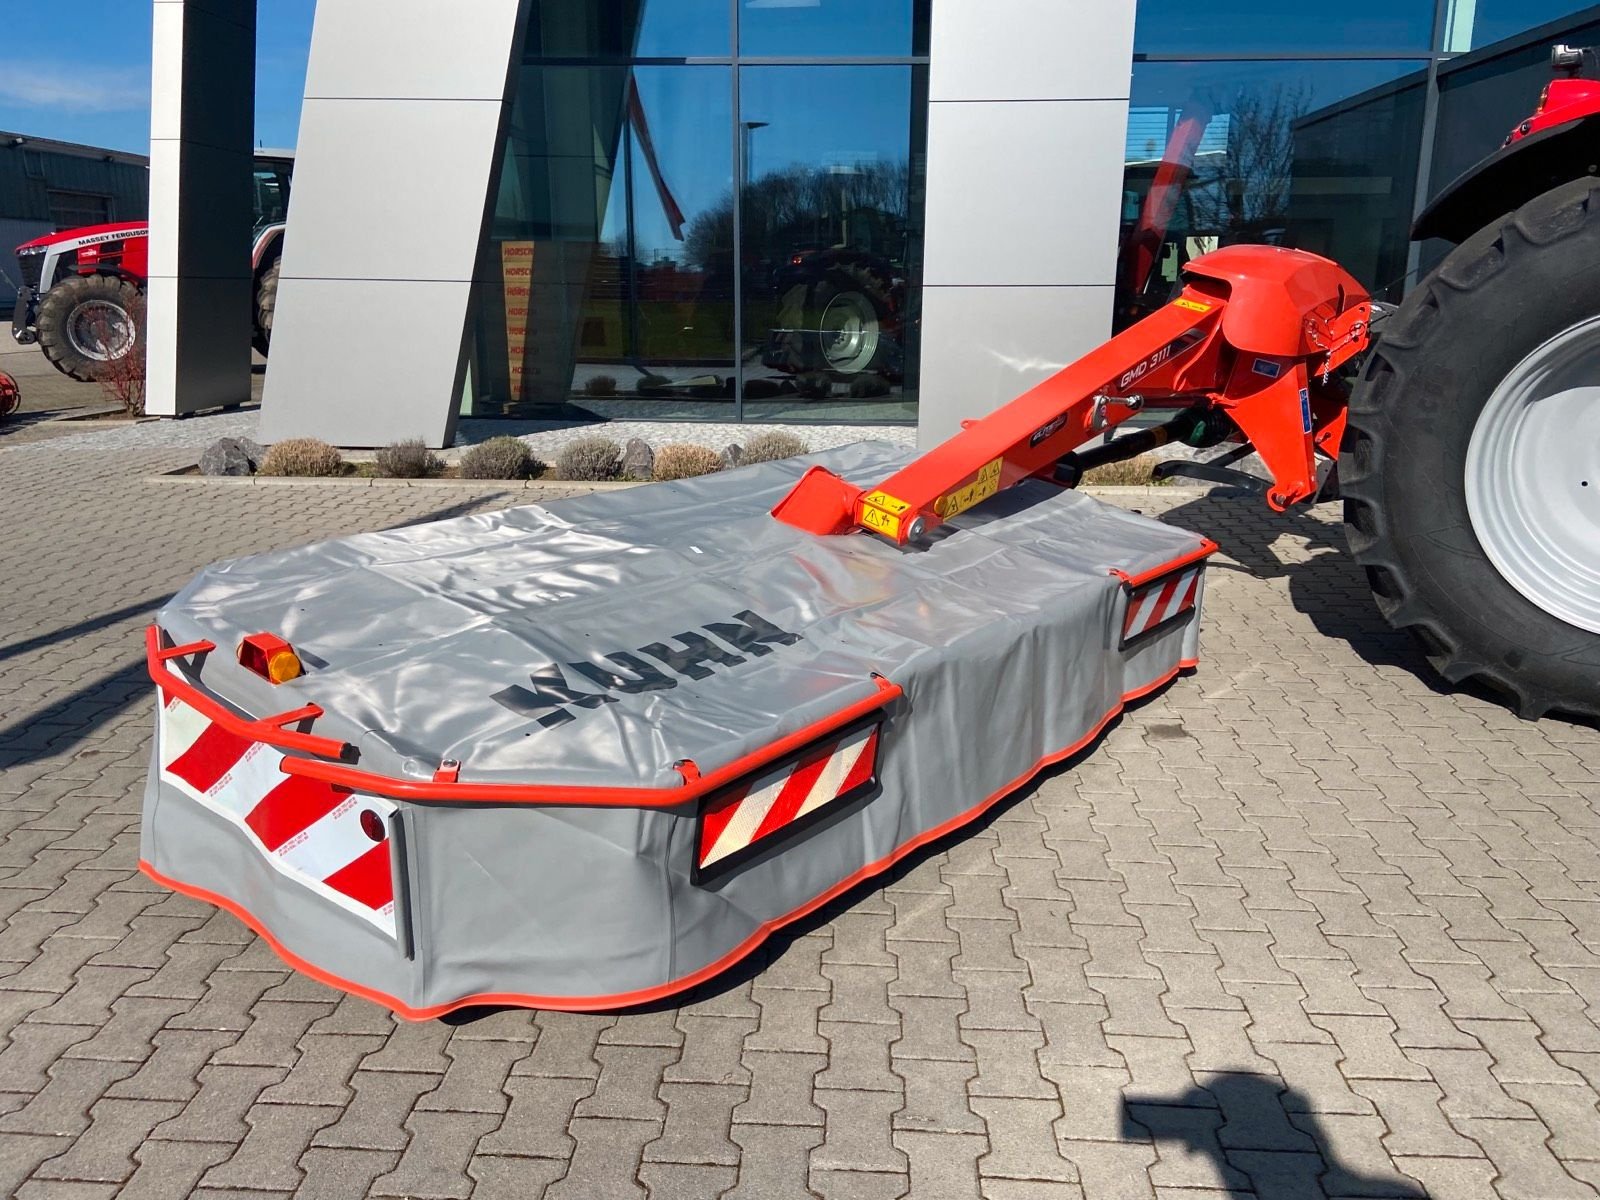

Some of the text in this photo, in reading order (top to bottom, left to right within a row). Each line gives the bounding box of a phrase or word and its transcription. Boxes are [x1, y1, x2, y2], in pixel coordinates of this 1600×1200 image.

[78, 235, 111, 246] MASSEY
[1120, 344, 1171, 388] GMD 3111
[489, 609, 804, 729] KUHN
